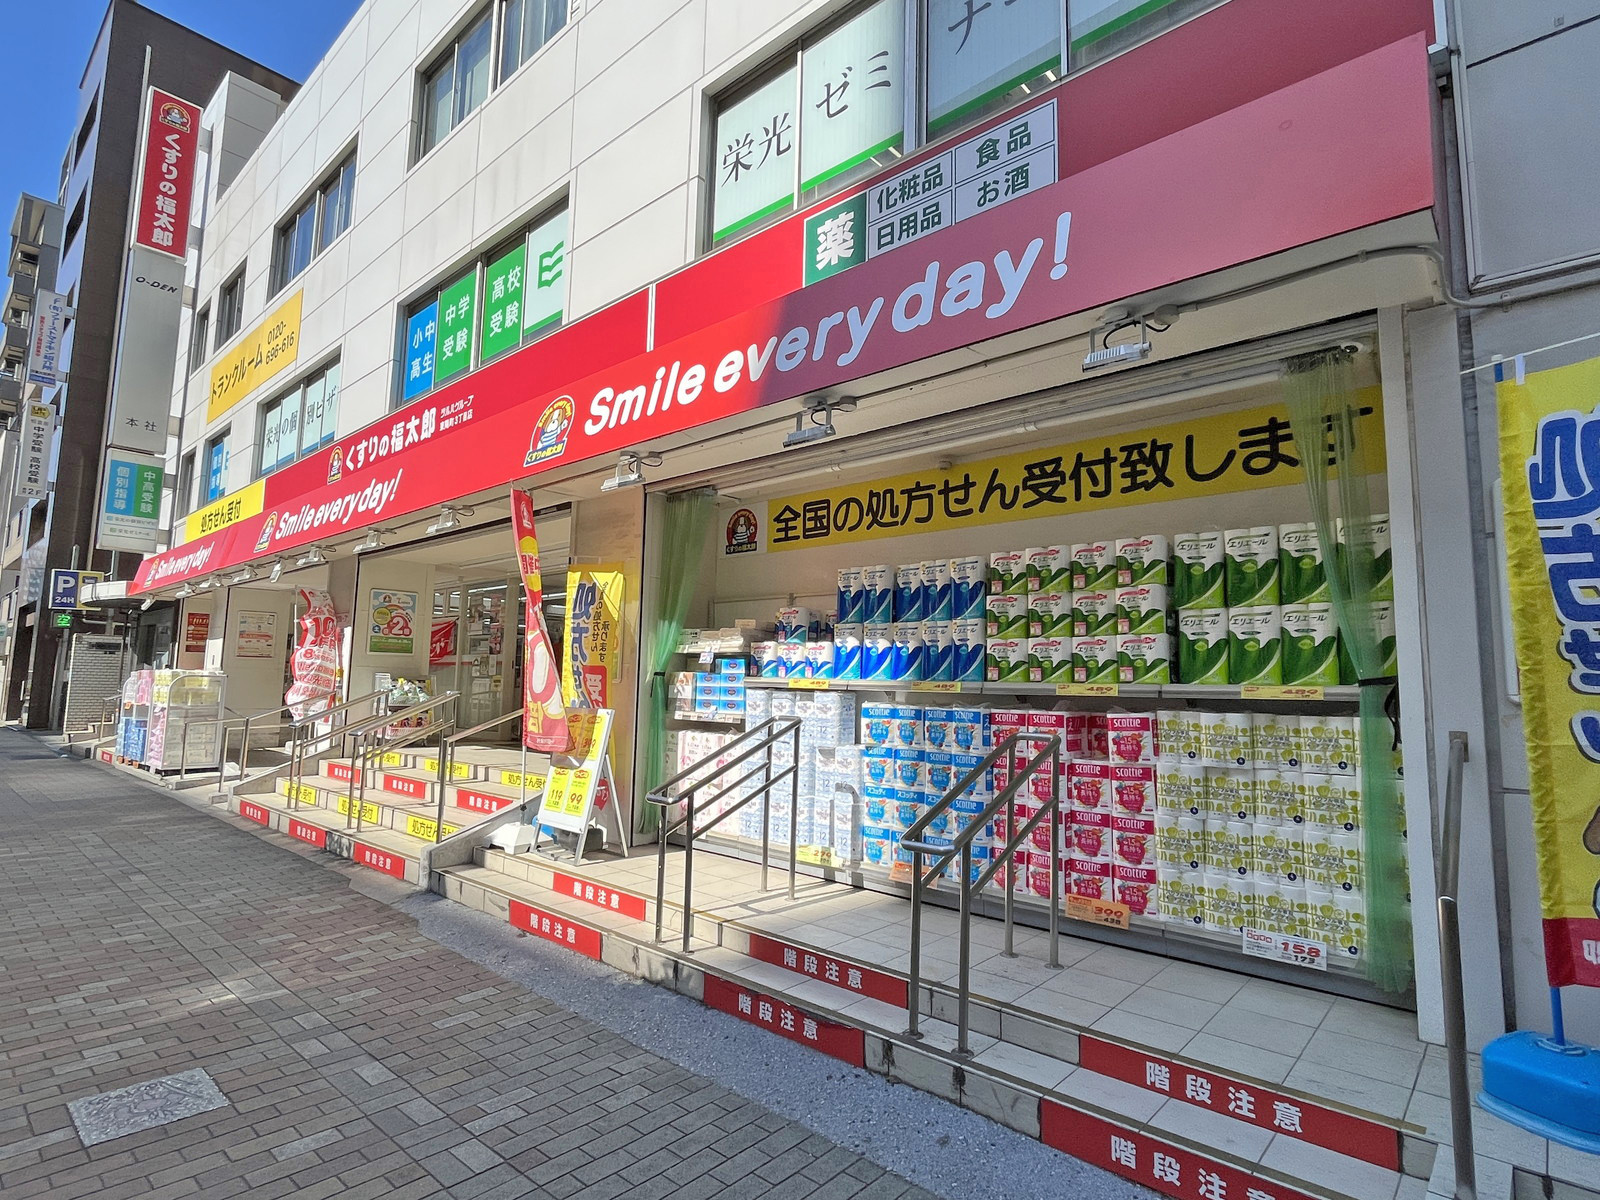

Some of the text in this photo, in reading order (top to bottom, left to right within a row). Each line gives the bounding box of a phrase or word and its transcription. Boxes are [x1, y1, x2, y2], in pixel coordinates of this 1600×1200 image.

[976, 121, 1031, 169] 食品
[152, 133, 182, 247] くすりの福太郎
[877, 162, 943, 213] 化粧品
[976, 162, 1029, 207] お酒
[816, 211, 855, 270] 薬
[877, 203, 942, 250] 日用品
[136, 276, 178, 294] O-DEN
[492, 265, 522, 303] 高校
[445, 294, 470, 327] 中学
[489, 301, 519, 337] 受験
[584, 211, 1072, 436] Smile every day!
[267, 320, 287, 345] 0120-
[412, 320, 435, 349] 小中
[442, 328, 468, 361] 受験
[211, 343, 264, 405] トランクルーム
[410, 351, 433, 382] 高生
[126, 417, 157, 432] 本社
[346, 407, 437, 471] くすりの福太郎
[113, 466, 130, 510] 個別指導
[140, 471, 156, 514] 中高受験
[200, 497, 242, 534] 処方せん受付
[275, 503, 313, 541] Smile
[1284, 533, 1318, 543] エリエー
[57, 576, 75, 593] P
[573, 881, 620, 909] 階段注意
[530, 913, 576, 945] 階段注意
[783, 947, 863, 989] 階段注意
[1280, 941, 1321, 958] 158
[738, 993, 818, 1041] 階段注意
[1145, 1061, 1304, 1134] 階段注意
